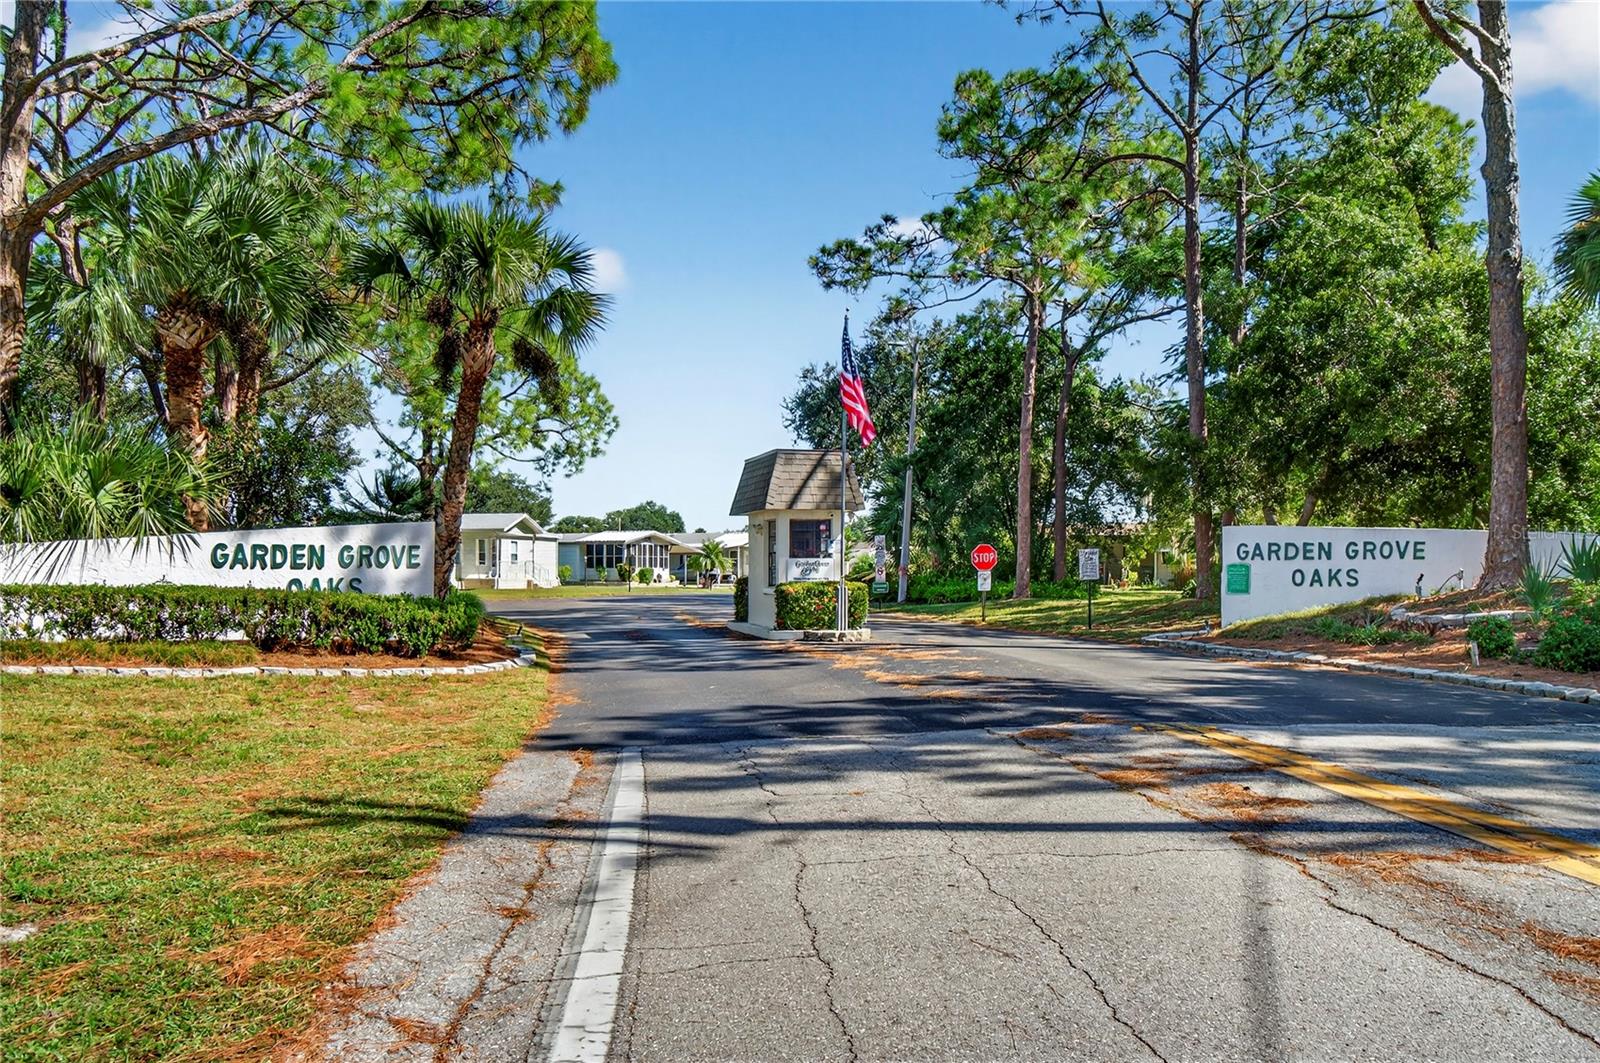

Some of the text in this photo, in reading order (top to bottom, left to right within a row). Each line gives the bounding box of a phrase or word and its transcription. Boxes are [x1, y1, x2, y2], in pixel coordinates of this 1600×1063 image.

[211, 543, 421, 570] GARDEN GROVE
[973, 552, 995, 563] STOP
[1236, 540, 1426, 561] GARDEN GROVE
[1291, 568, 1359, 587] OAKS
